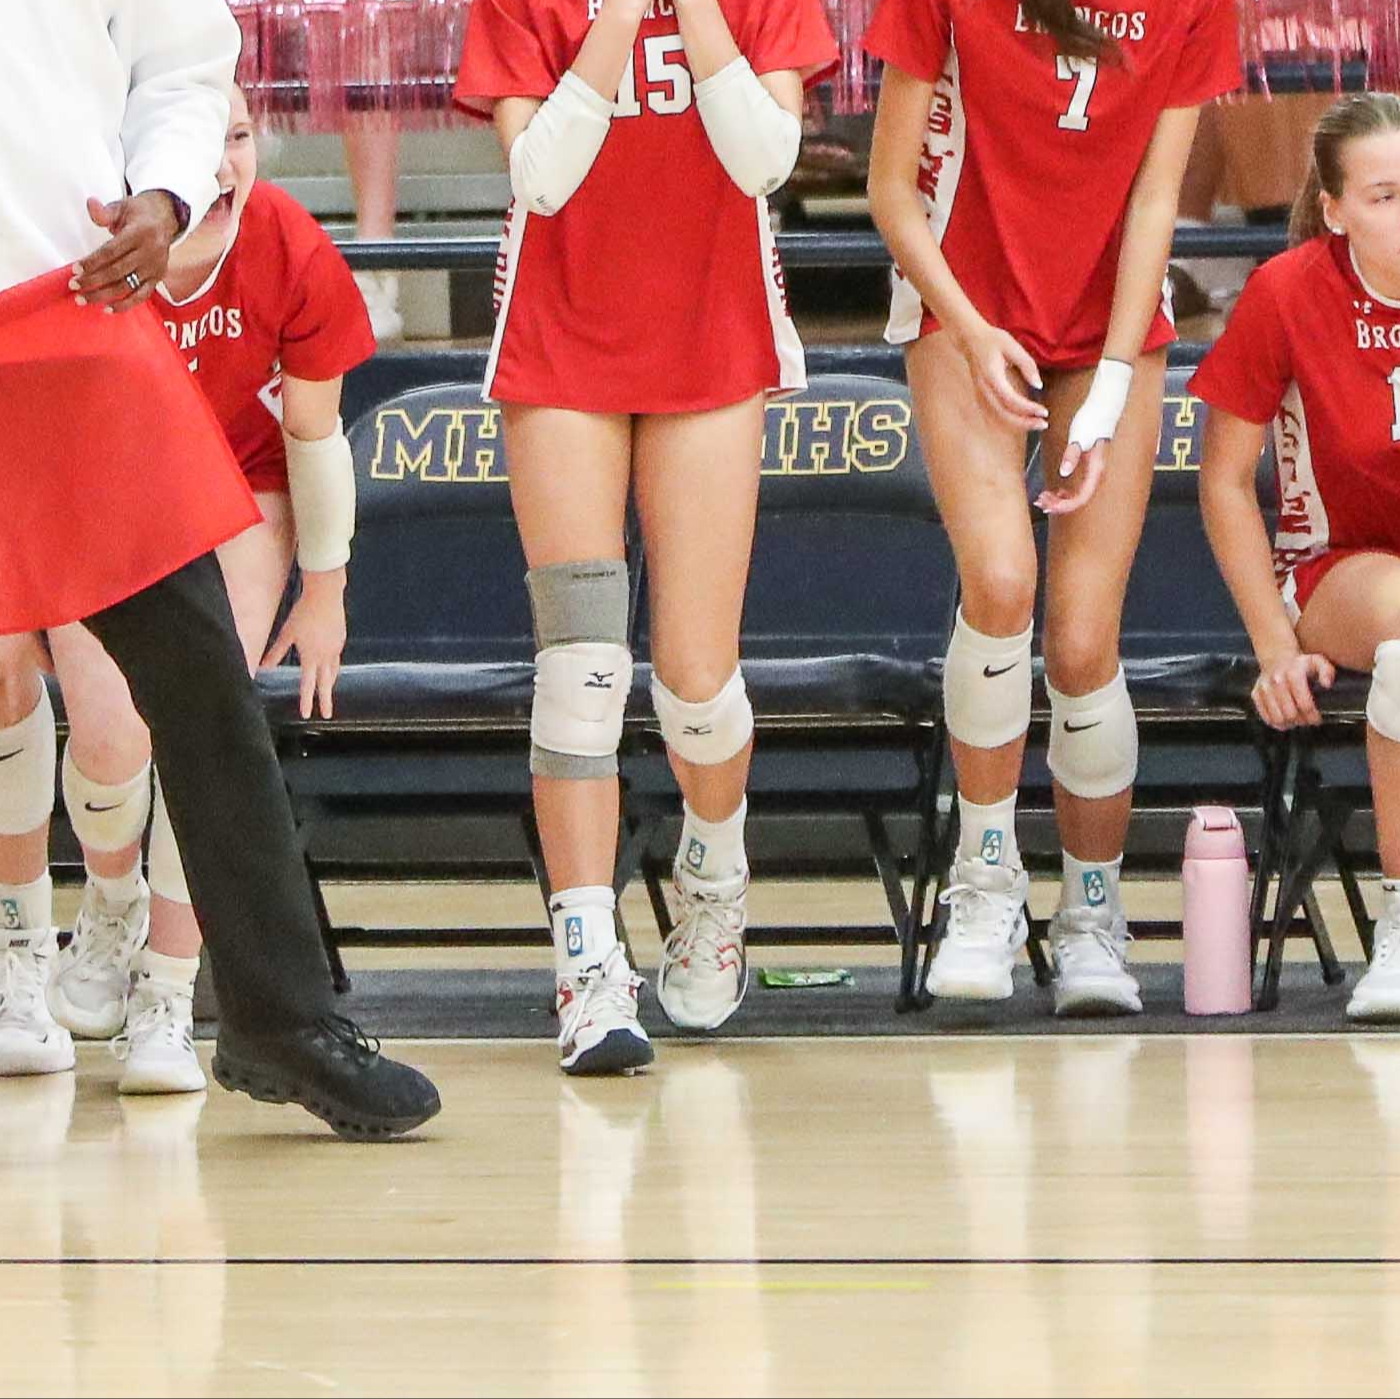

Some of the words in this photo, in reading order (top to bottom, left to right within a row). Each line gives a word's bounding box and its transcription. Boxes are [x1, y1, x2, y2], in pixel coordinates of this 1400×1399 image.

[611, 33, 693, 117] 15
[1055, 53, 1098, 131] 7
[370, 408, 510, 483] MH
